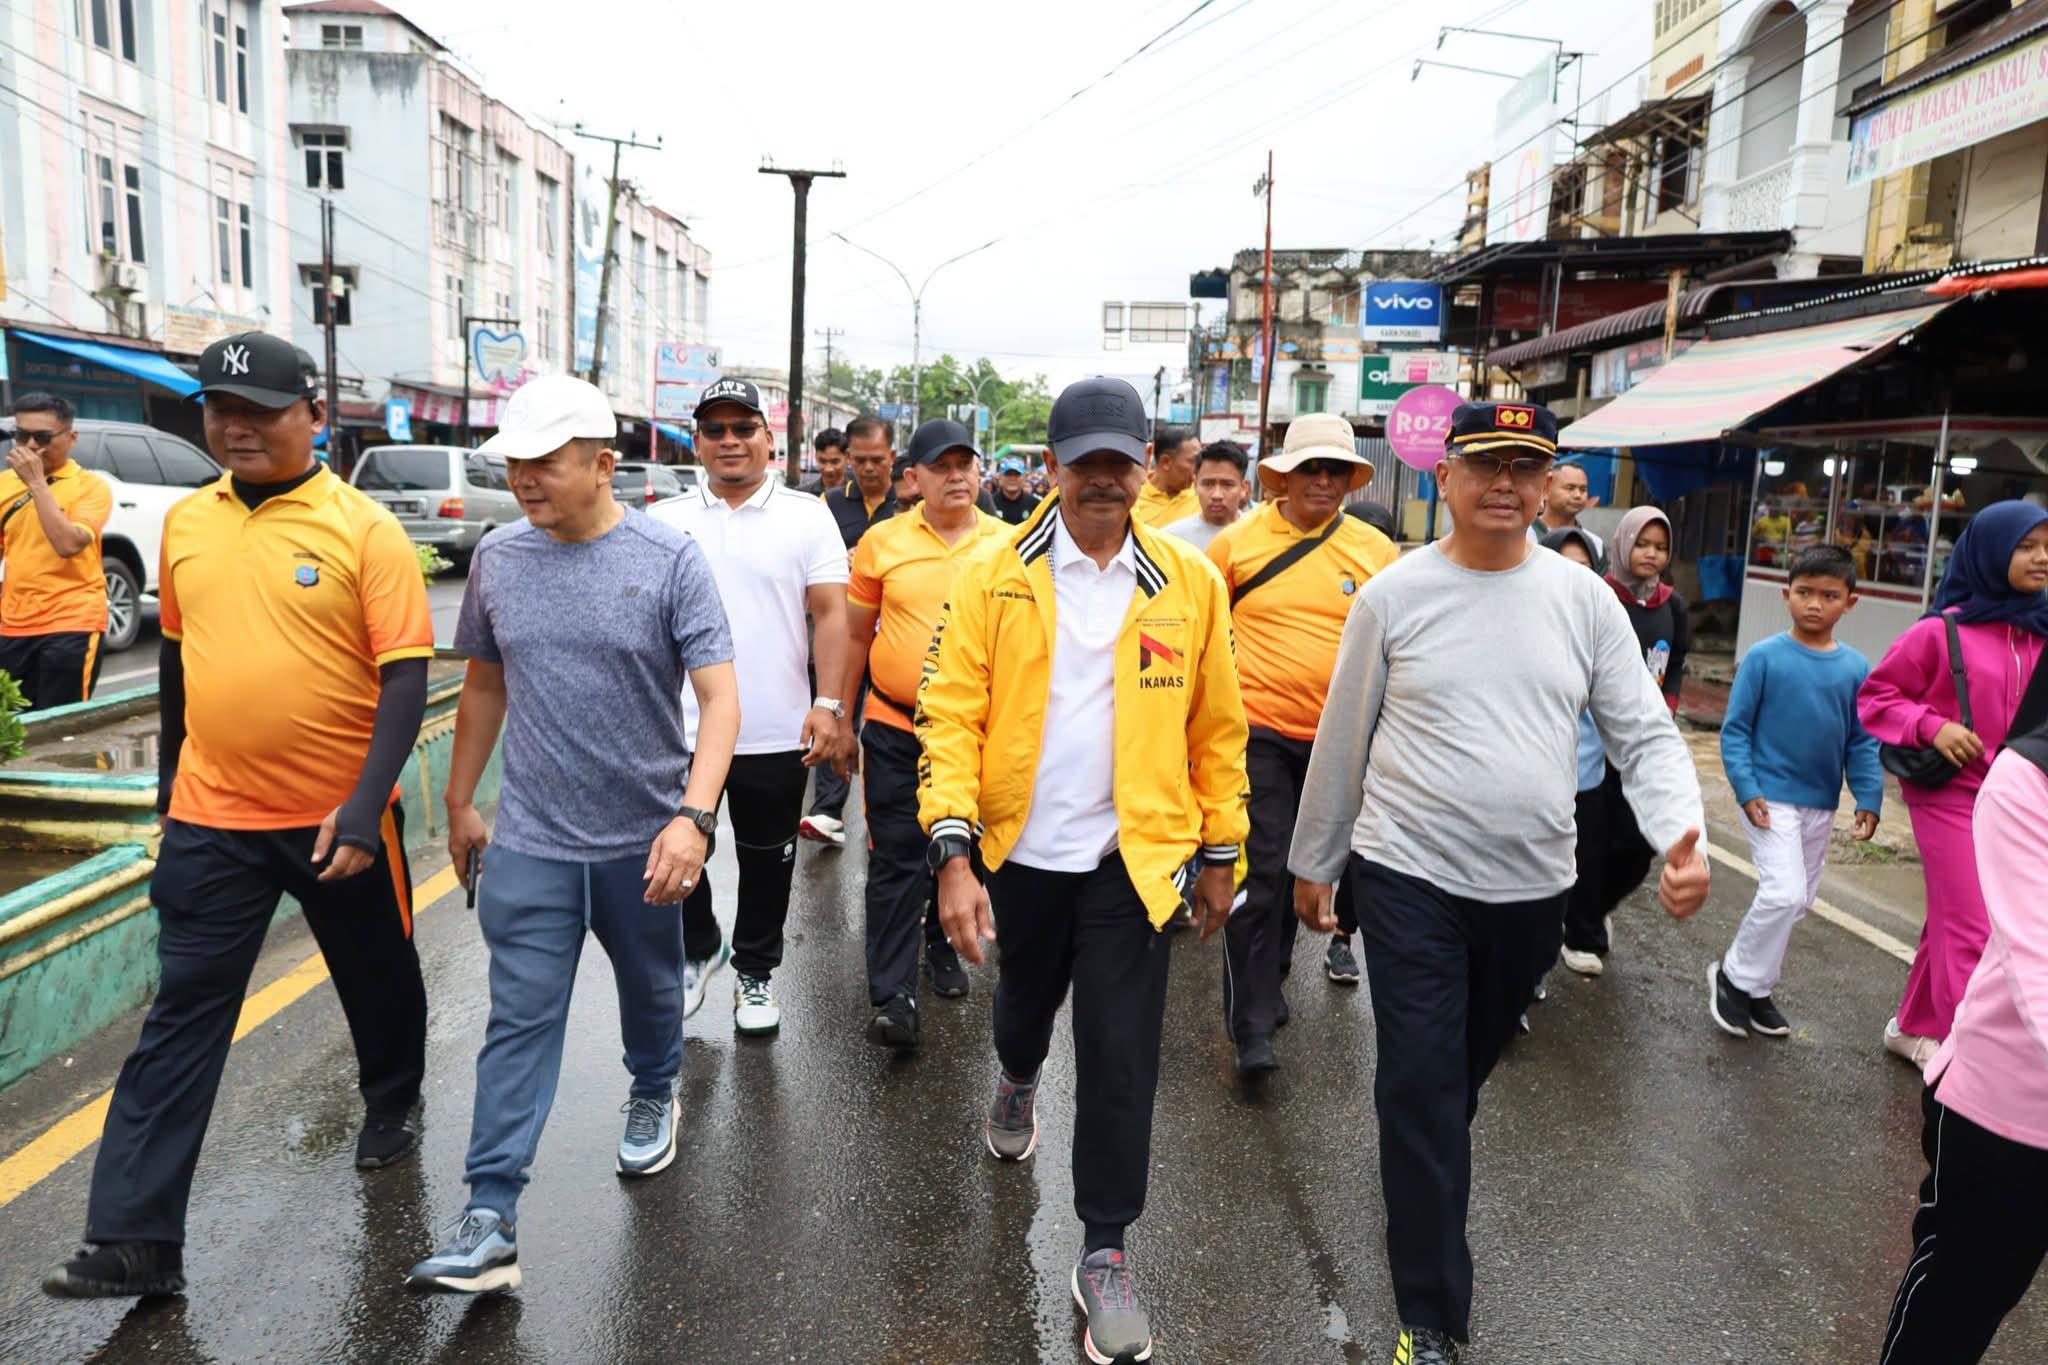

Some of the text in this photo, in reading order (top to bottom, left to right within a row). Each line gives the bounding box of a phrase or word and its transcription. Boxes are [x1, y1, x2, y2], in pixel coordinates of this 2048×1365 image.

[1869, 101, 1917, 149] RUMAH
[1919, 77, 1972, 128] MAKAN
[1974, 49, 2034, 107] DANAU
[1373, 293, 1433, 310] vivo
[221, 343, 251, 376] NY
[704, 380, 747, 400] PTWP
[1140, 676, 1184, 689] IKANAS
